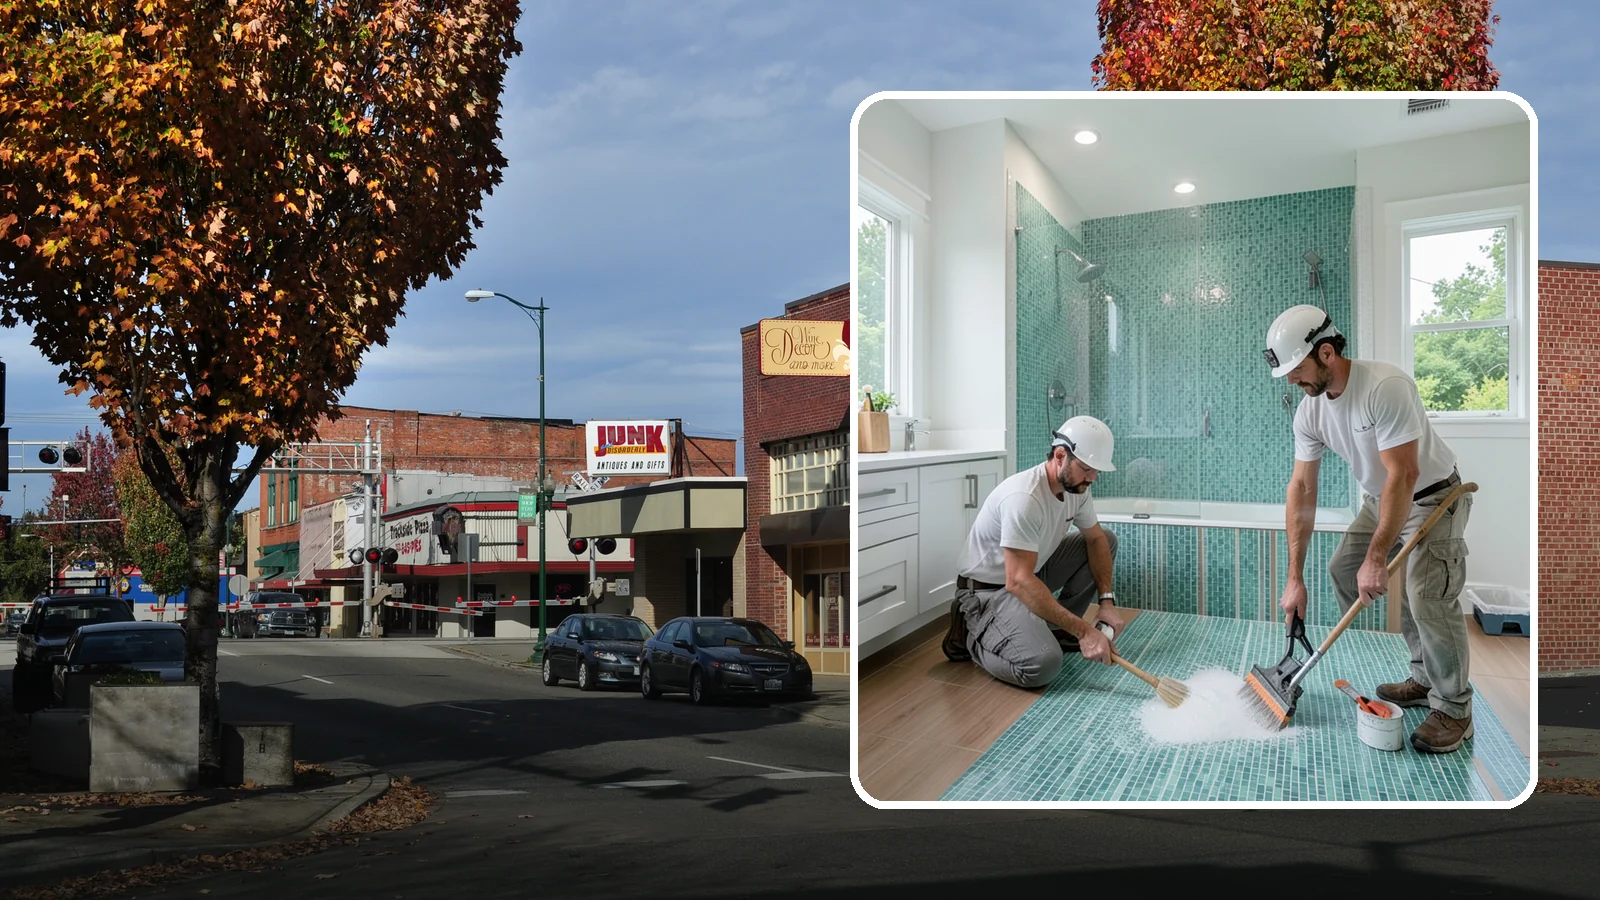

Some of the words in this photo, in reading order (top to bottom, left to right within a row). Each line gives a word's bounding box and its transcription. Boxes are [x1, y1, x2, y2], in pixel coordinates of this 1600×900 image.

[595, 425, 666, 457] JUNK
[607, 445, 646, 454] DISORDERLY
[597, 461, 628, 470] ANTIQUES
[631, 461, 644, 470] AND
[647, 460, 666, 469] GIFTS
[390, 521, 413, 540] Trackside
[414, 519, 429, 535] Pizza
